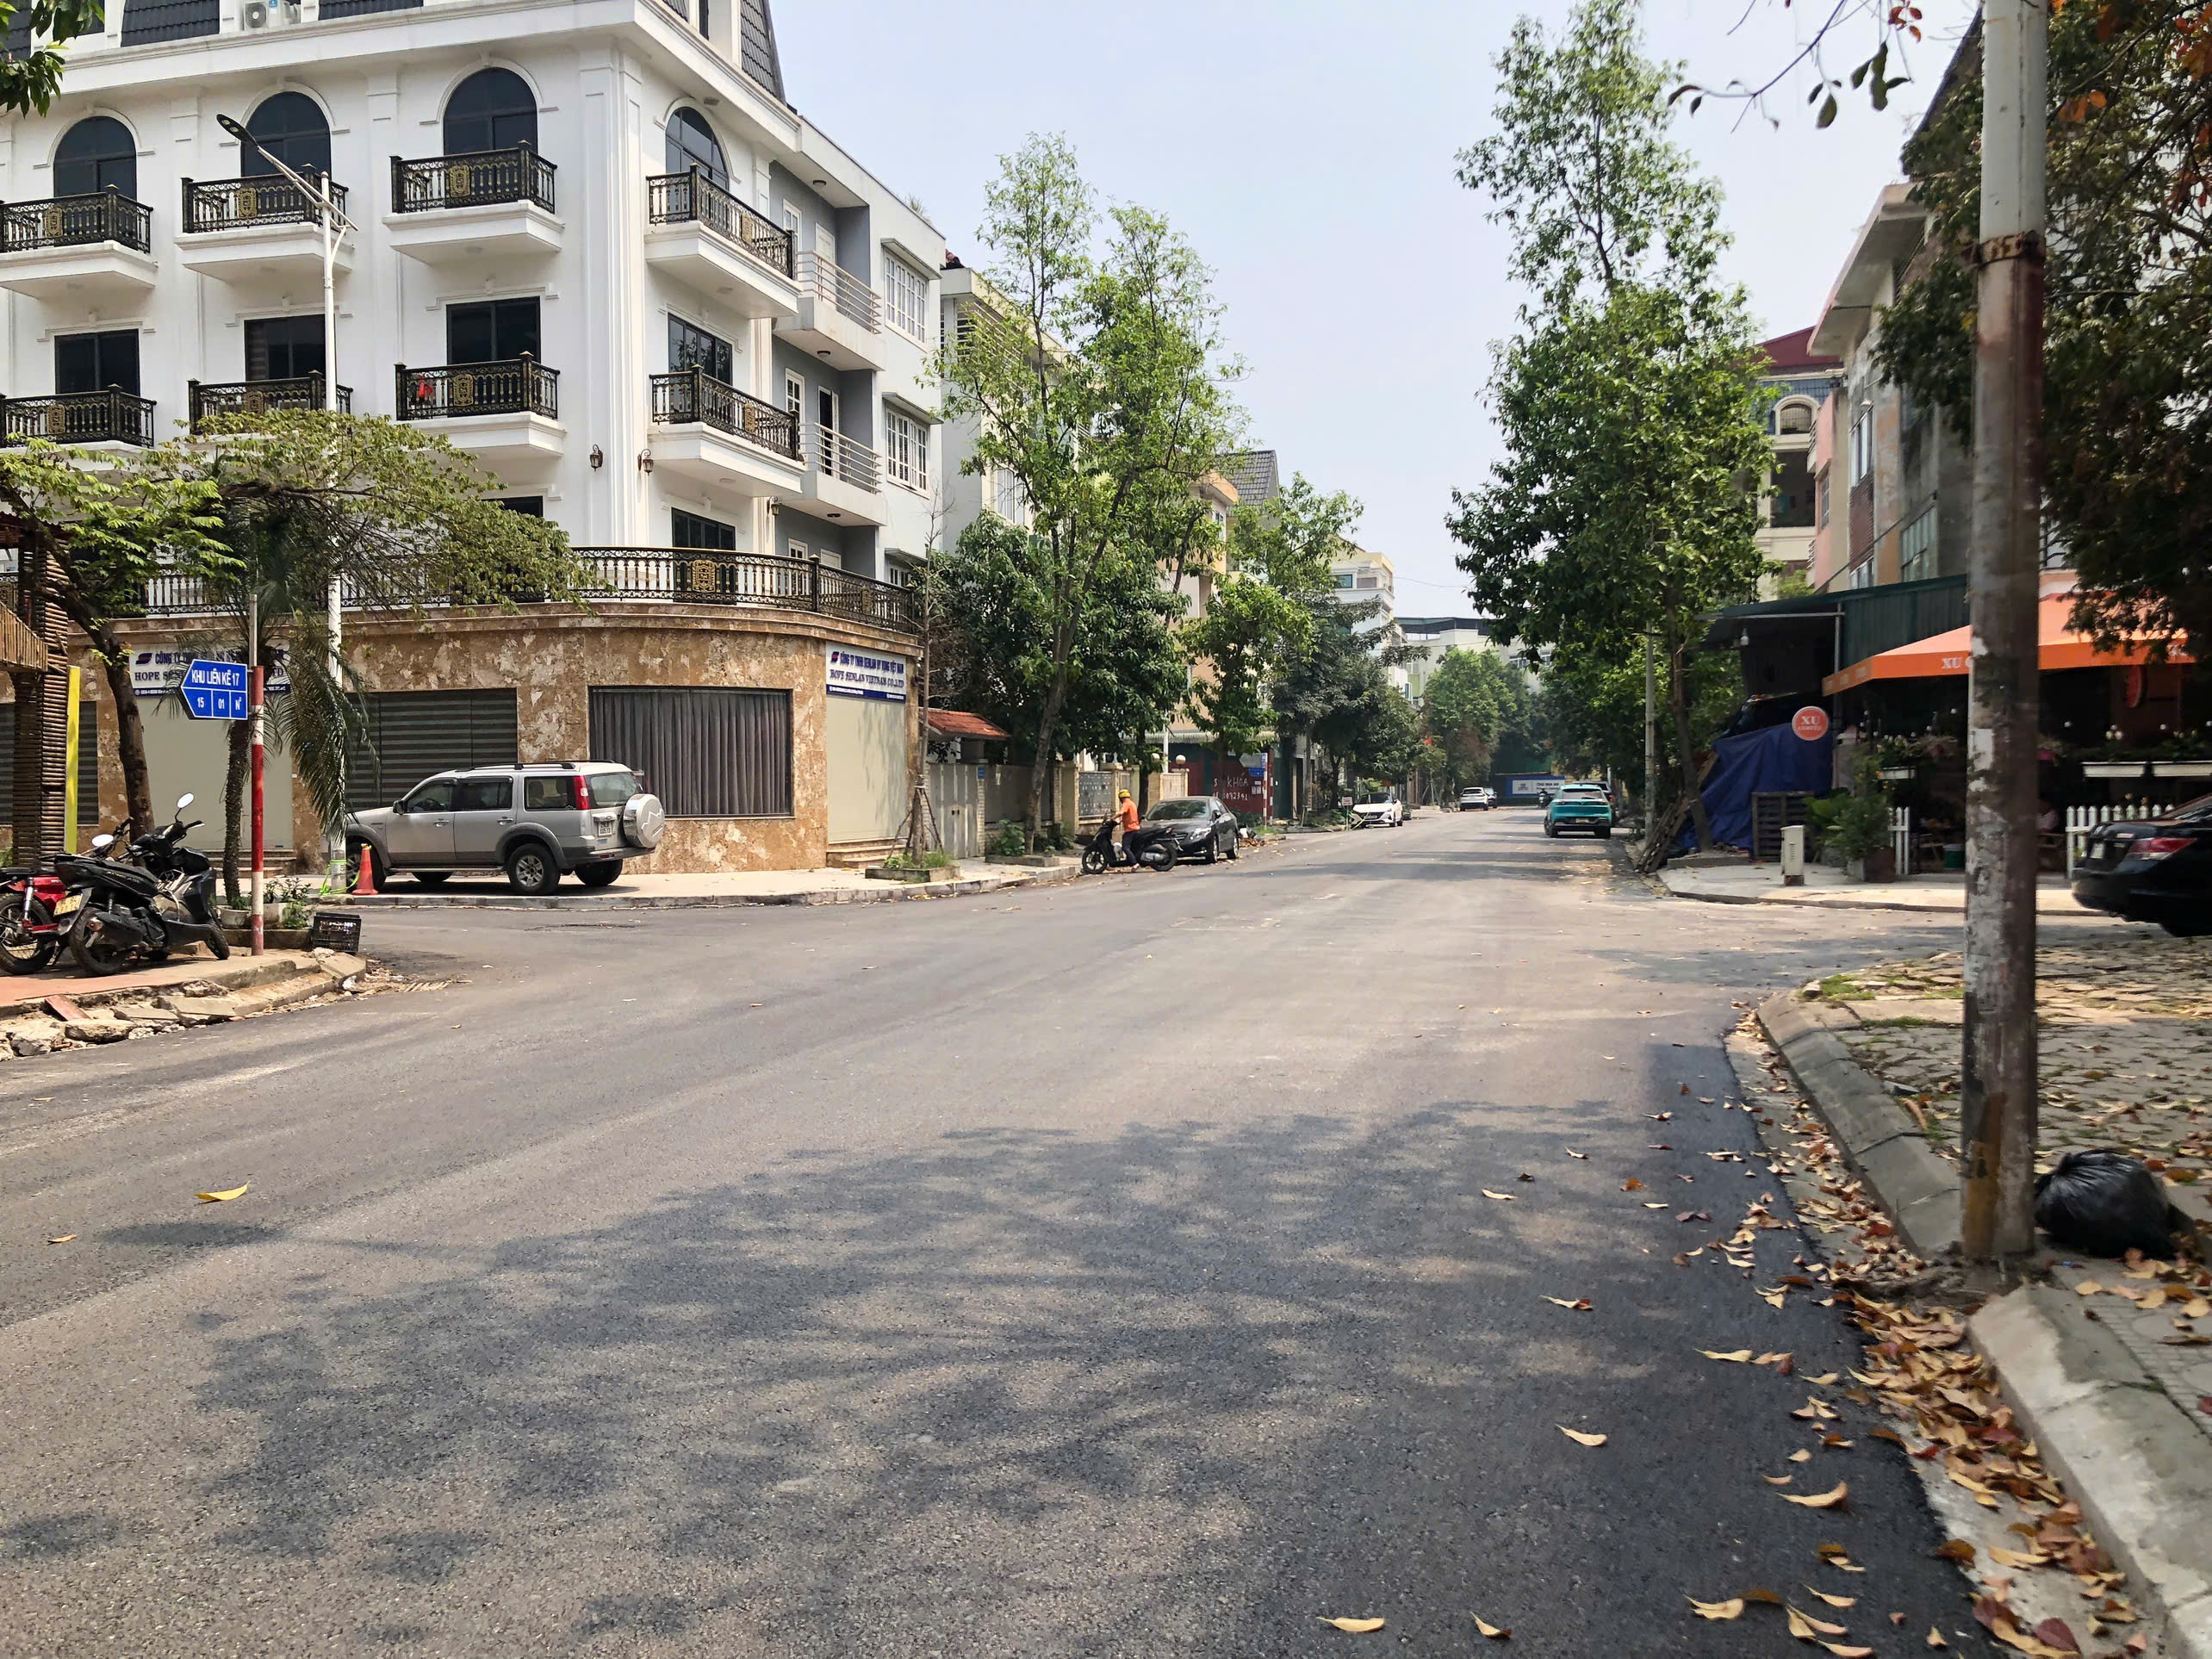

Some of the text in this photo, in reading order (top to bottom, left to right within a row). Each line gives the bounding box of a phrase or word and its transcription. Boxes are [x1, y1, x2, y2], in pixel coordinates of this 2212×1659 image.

[1941, 656, 1962, 669] XU
[134, 671, 160, 681] HOPE
[191, 668, 205, 684] KHU
[233, 673, 239, 687] 17
[196, 696, 205, 708] 15
[218, 698, 225, 710] 01
[1801, 716, 1820, 724] XU
